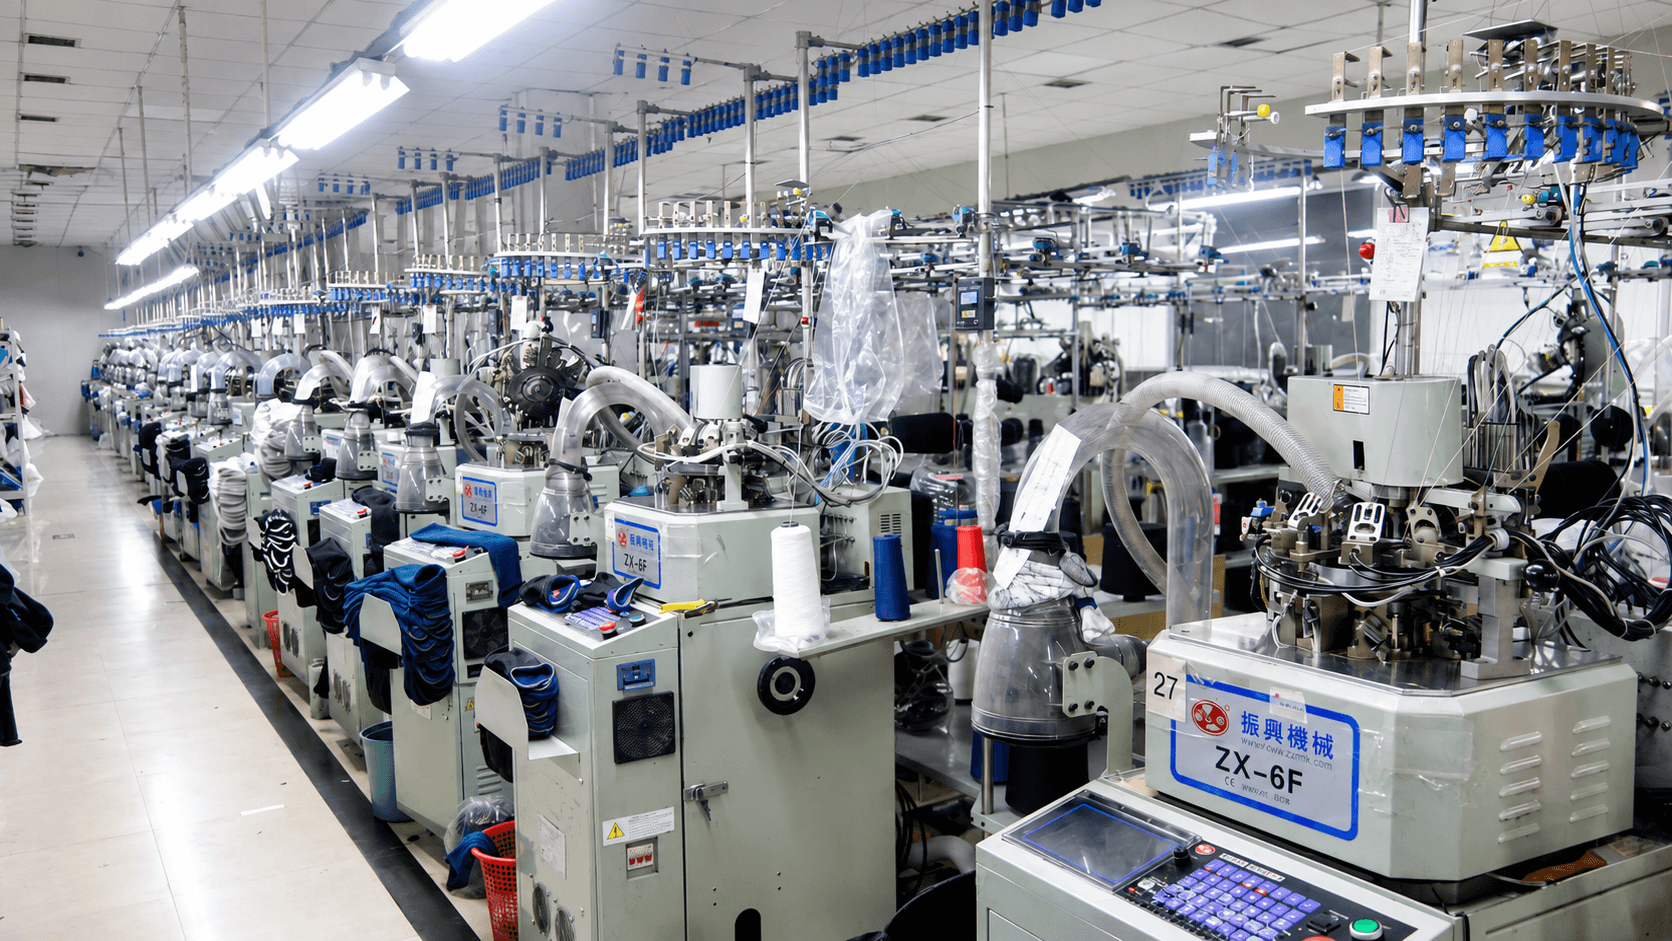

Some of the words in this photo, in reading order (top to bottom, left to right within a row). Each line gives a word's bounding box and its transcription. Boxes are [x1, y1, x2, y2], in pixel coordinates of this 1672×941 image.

[1153, 671, 1178, 699] 27
[1240, 710, 1334, 760] 振興機械
[1215, 745, 1303, 794] ZX-6F
